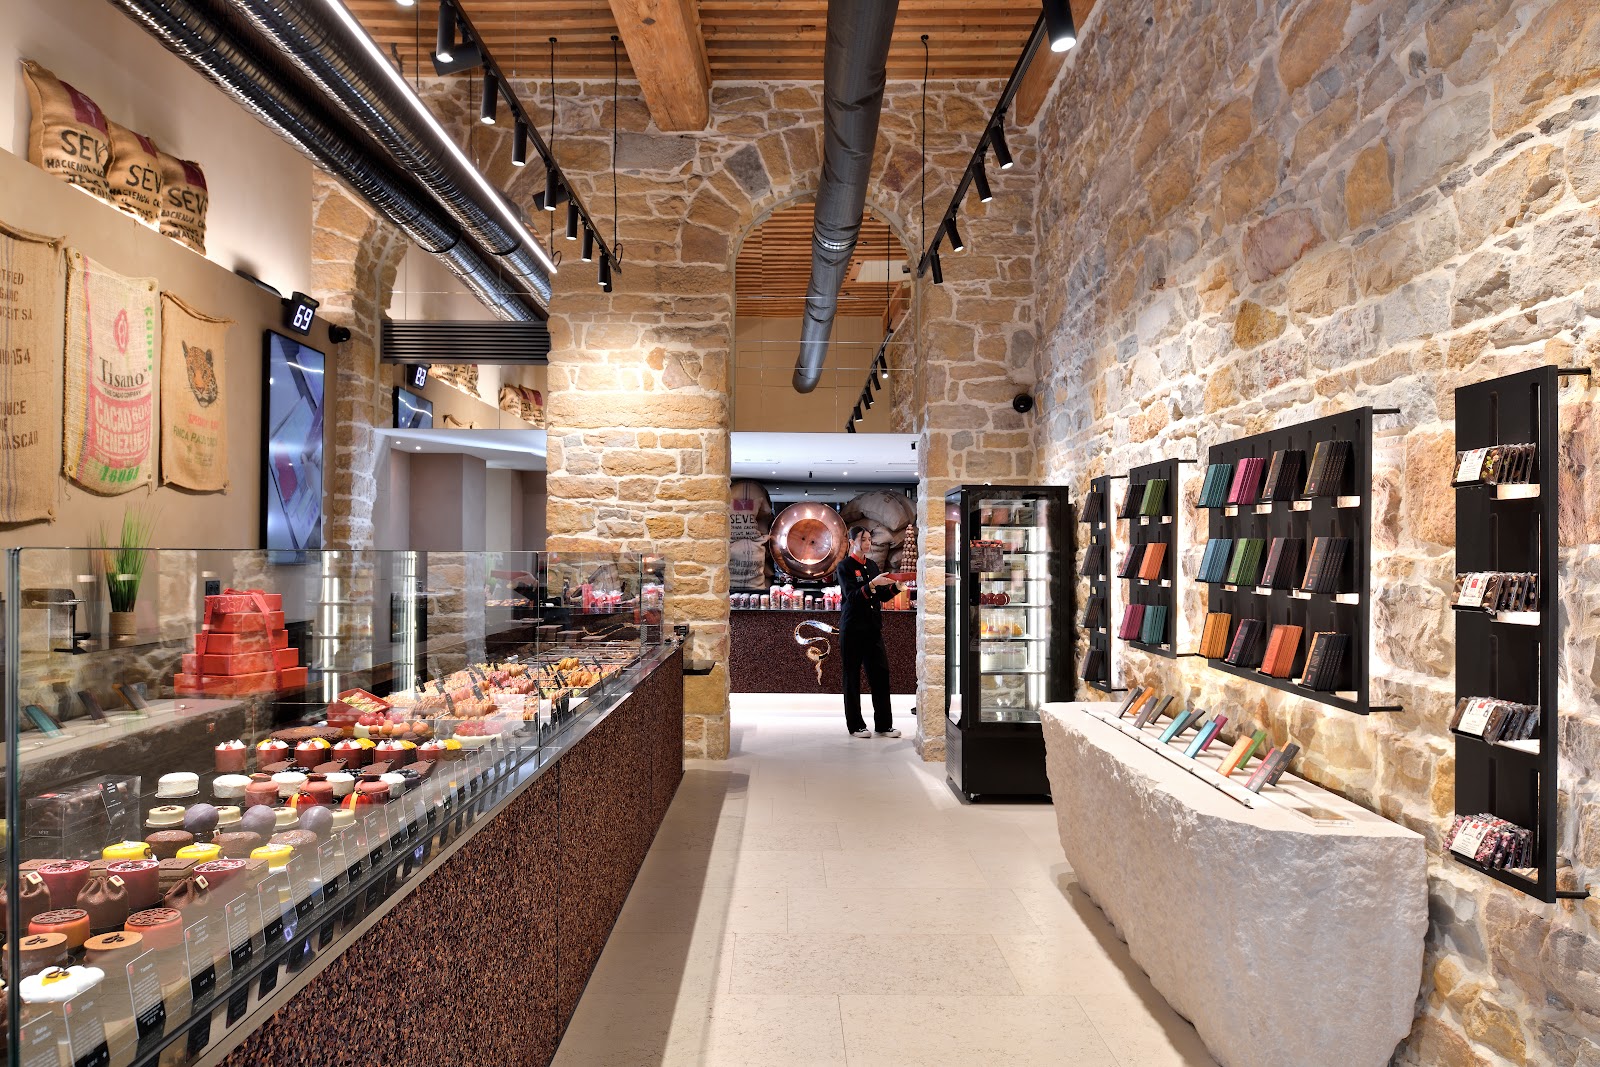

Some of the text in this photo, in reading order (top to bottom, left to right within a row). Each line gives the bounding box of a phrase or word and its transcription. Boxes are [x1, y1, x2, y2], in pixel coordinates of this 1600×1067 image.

[293, 304, 313, 331] 69
[99, 356, 145, 388] Tisano
[95, 395, 133, 433] CACAO
